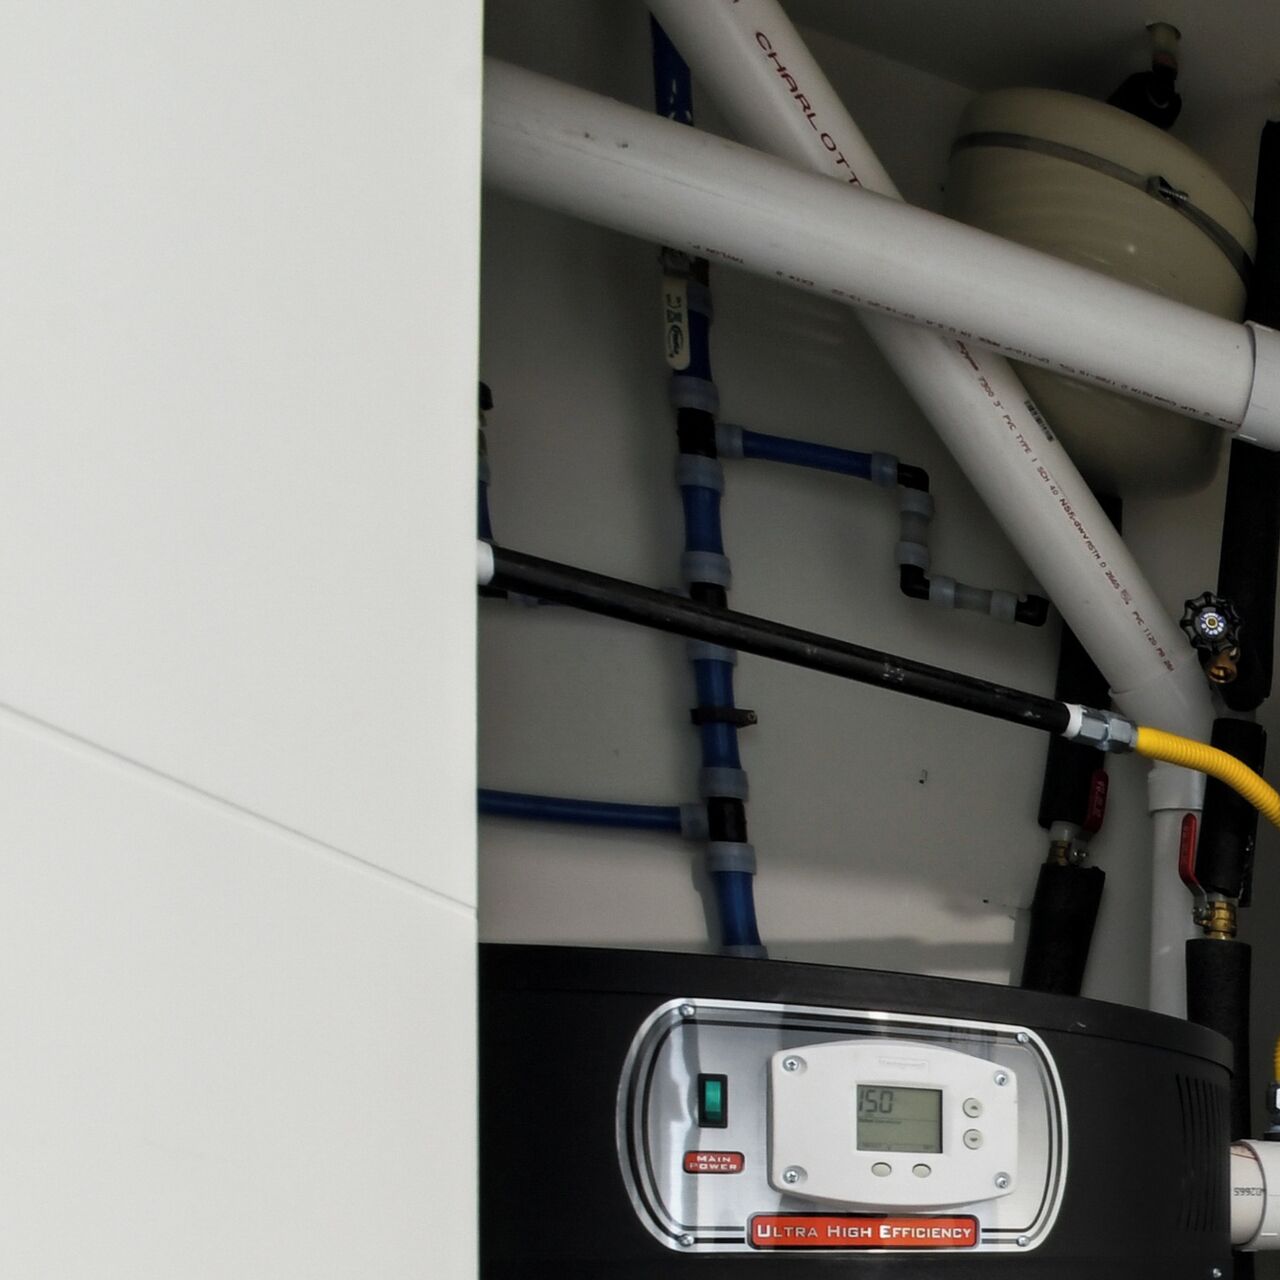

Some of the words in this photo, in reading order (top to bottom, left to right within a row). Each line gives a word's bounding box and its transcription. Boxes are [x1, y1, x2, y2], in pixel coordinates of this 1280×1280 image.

[1001, 413, 1017, 432] PVC
[1014, 433, 1032, 455] TYPE
[1035, 465, 1050, 483] SCH
[859, 1088, 894, 1114] 150
[690, 1162, 737, 1170] POWER
[697, 1155, 731, 1163] MAIN
[757, 1224, 819, 1239] ULTRA
[827, 1224, 872, 1239] HIGH
[879, 1224, 973, 1240] EFFICIENCY
